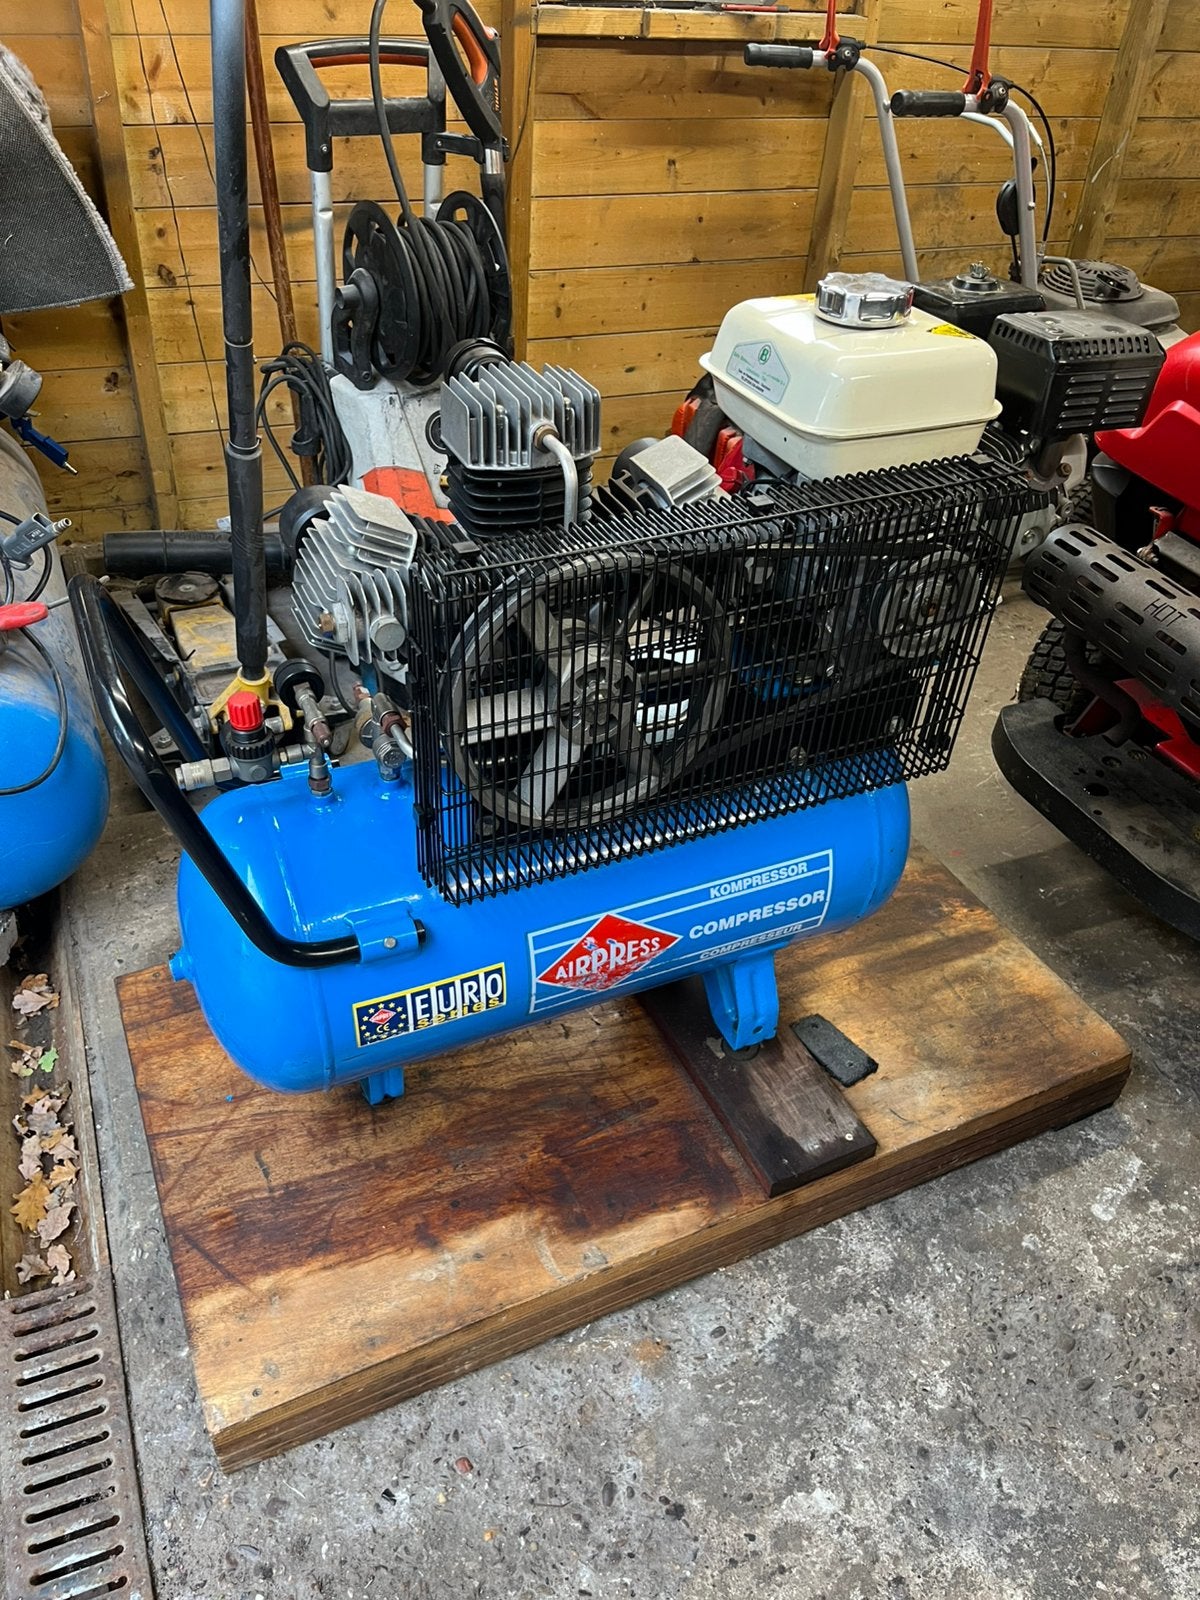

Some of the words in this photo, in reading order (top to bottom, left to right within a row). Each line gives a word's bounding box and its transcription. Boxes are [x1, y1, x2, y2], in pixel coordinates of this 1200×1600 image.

[1143, 598, 1188, 627] HOT
[710, 862, 807, 899] KOMPRESSOR
[689, 889, 825, 940] COMPRESSOR
[555, 937, 660, 980] AIRPRESS
[700, 924, 802, 960] COMPRESSEUR
[415, 973, 503, 1020] EURO
[416, 997, 500, 1029] series
